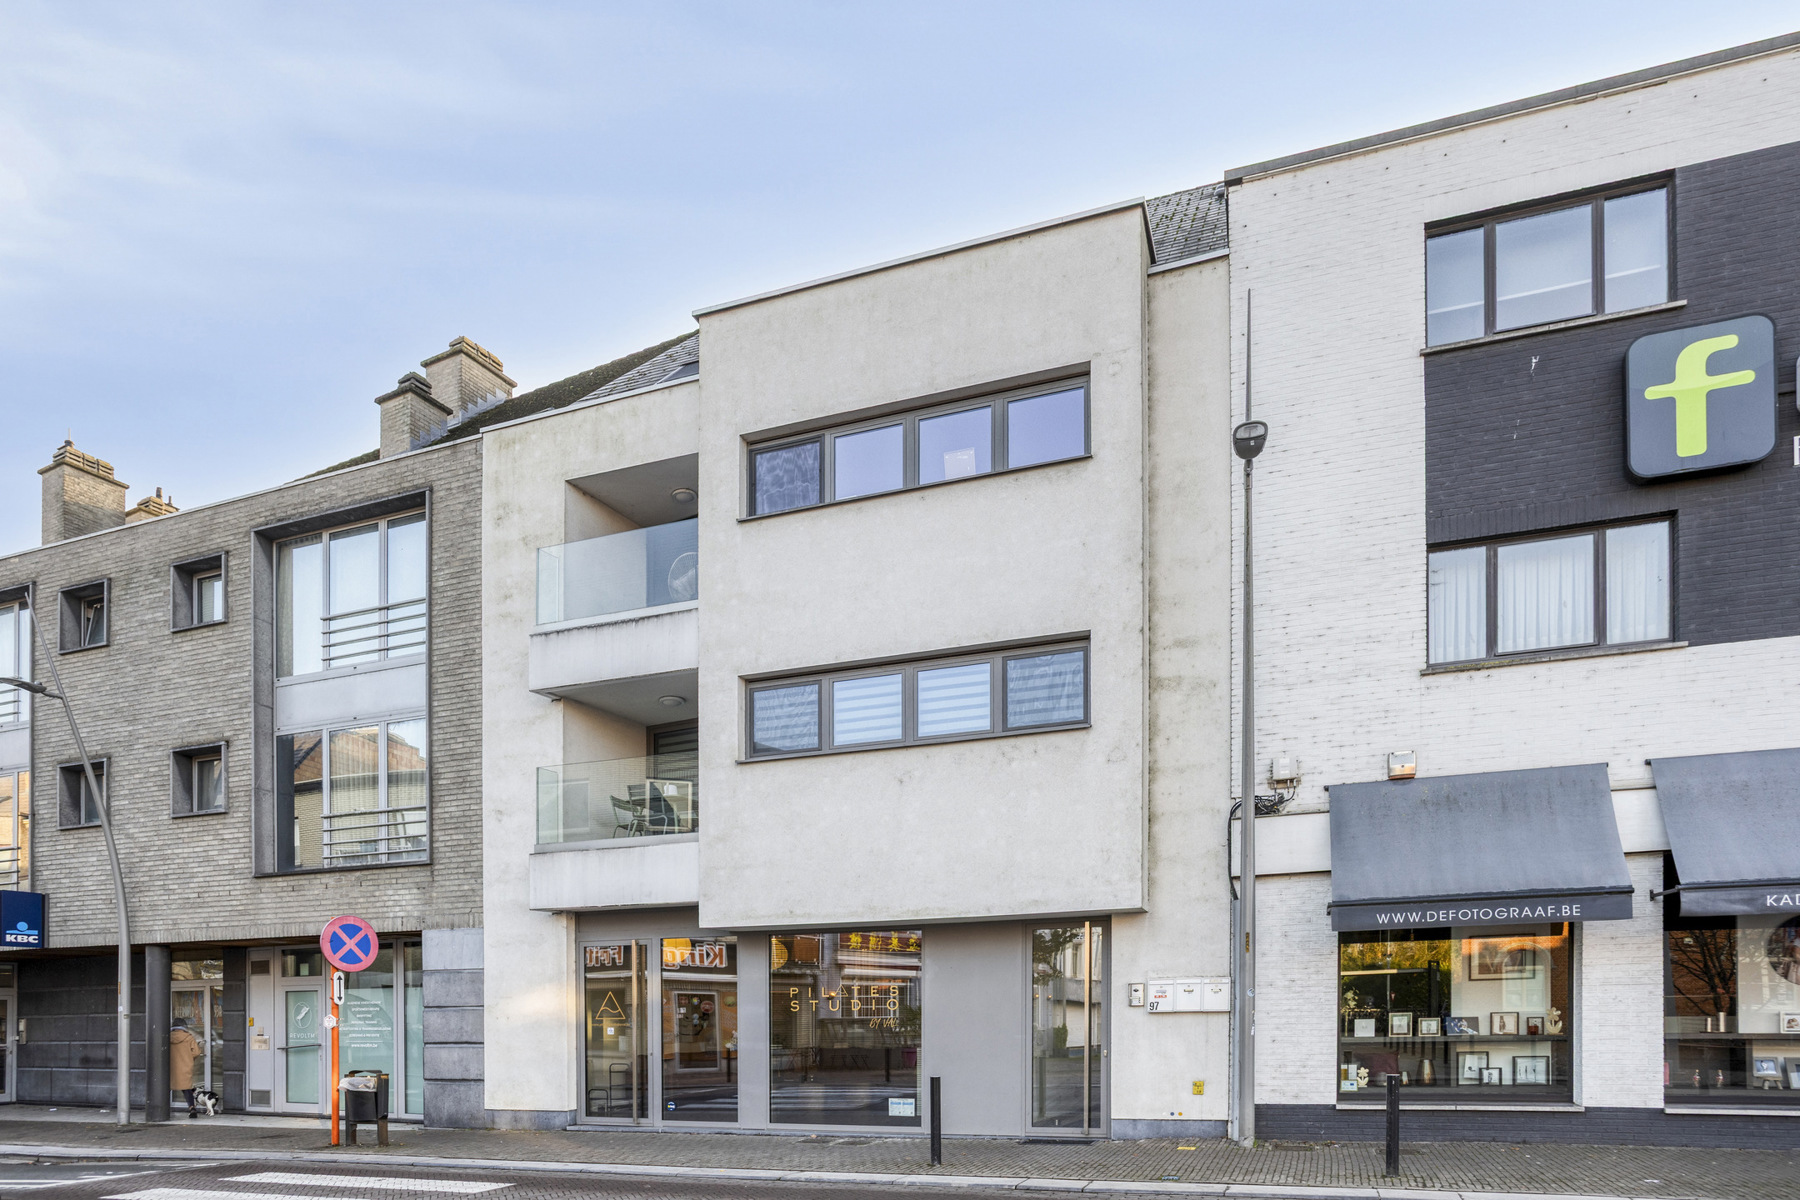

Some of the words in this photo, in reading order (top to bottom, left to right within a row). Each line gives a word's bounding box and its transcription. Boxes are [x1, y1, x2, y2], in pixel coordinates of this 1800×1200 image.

[1644, 334, 1756, 458] f
[1376, 904, 1581, 924] WWW.DEFOTOGRAAF.BE
[5, 934, 39, 943] KBC
[789, 983, 899, 998] PILATES
[790, 998, 899, 1012] STUDIO
[1149, 1001, 1160, 1011] 97
[869, 1018, 881, 1029] BY
